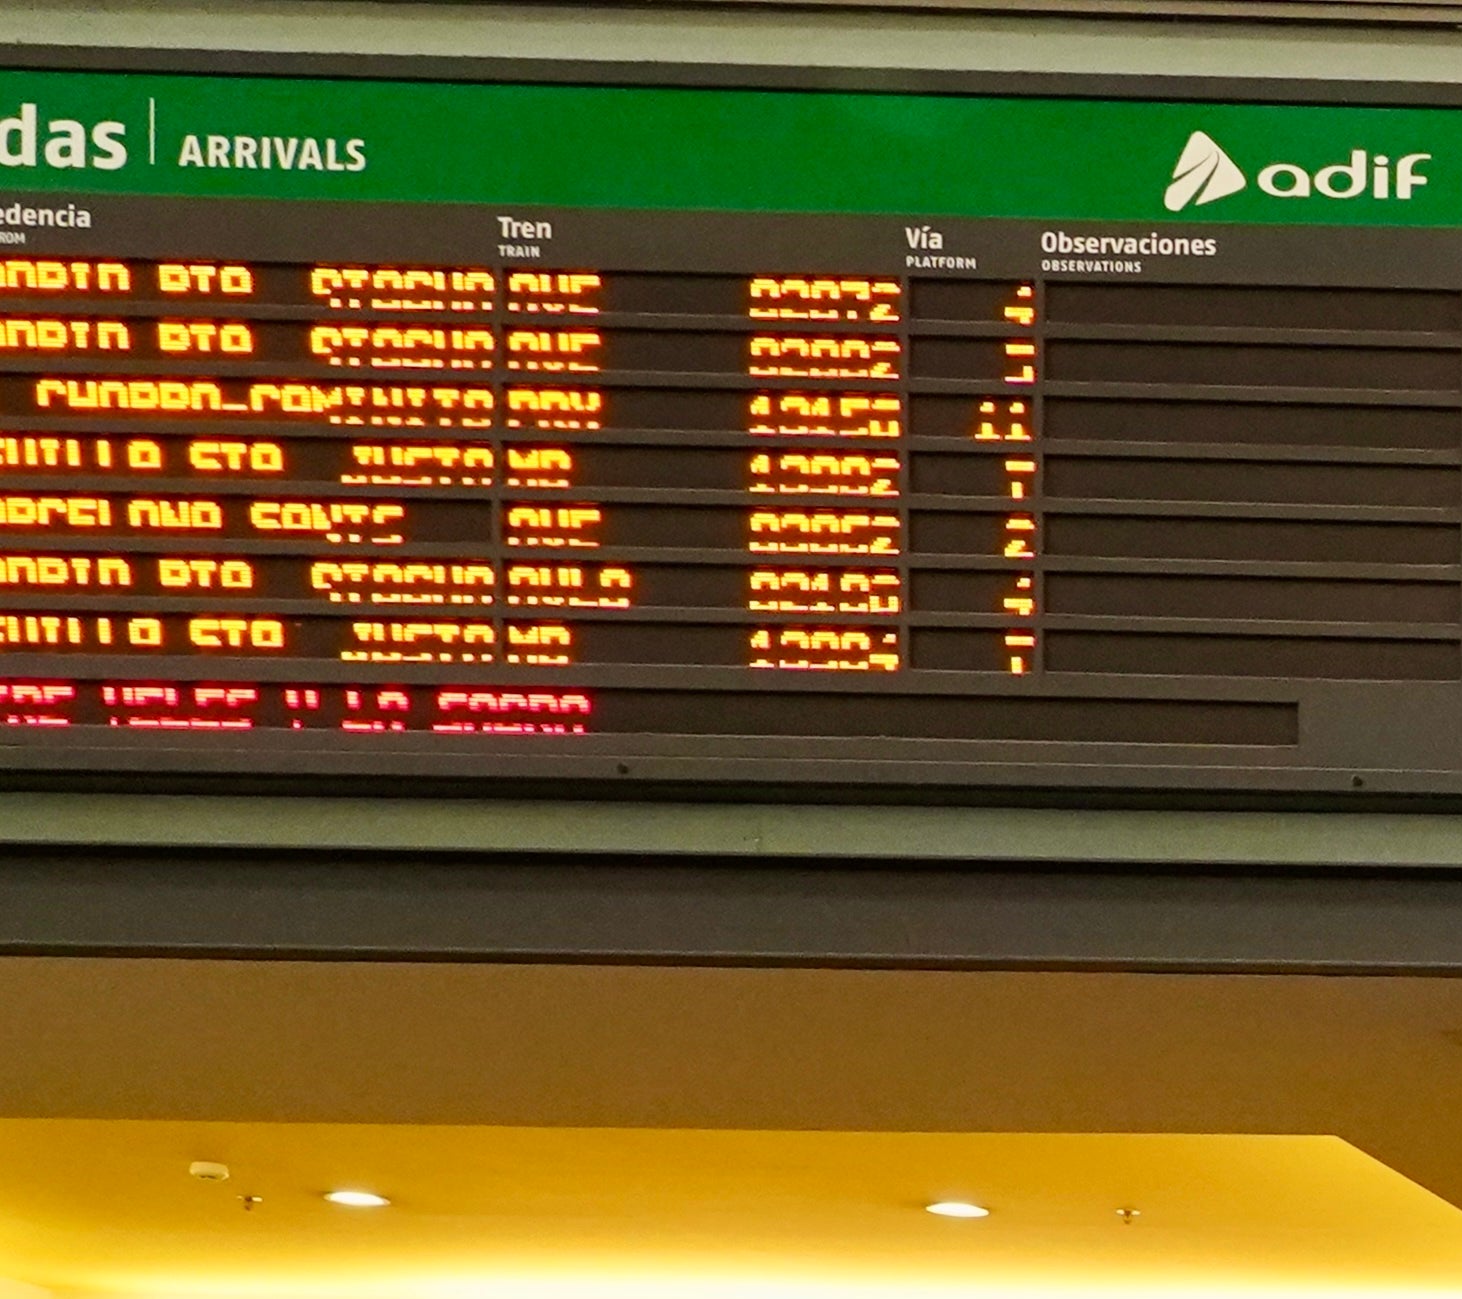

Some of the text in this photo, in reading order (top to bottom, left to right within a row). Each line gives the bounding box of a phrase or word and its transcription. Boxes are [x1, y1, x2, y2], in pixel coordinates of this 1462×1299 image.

[179, 137, 366, 172] ARRIVALS
[1257, 150, 1431, 200] adif
[0, 203, 91, 229] dencia
[498, 216, 551, 239] Tren
[905, 227, 942, 250] Vía
[1041, 232, 1216, 257] Observaciones
[499, 245, 539, 257] TRAIN
[906, 257, 976, 269] PLATFORM
[1042, 261, 1141, 273] OBSERVATIONS
